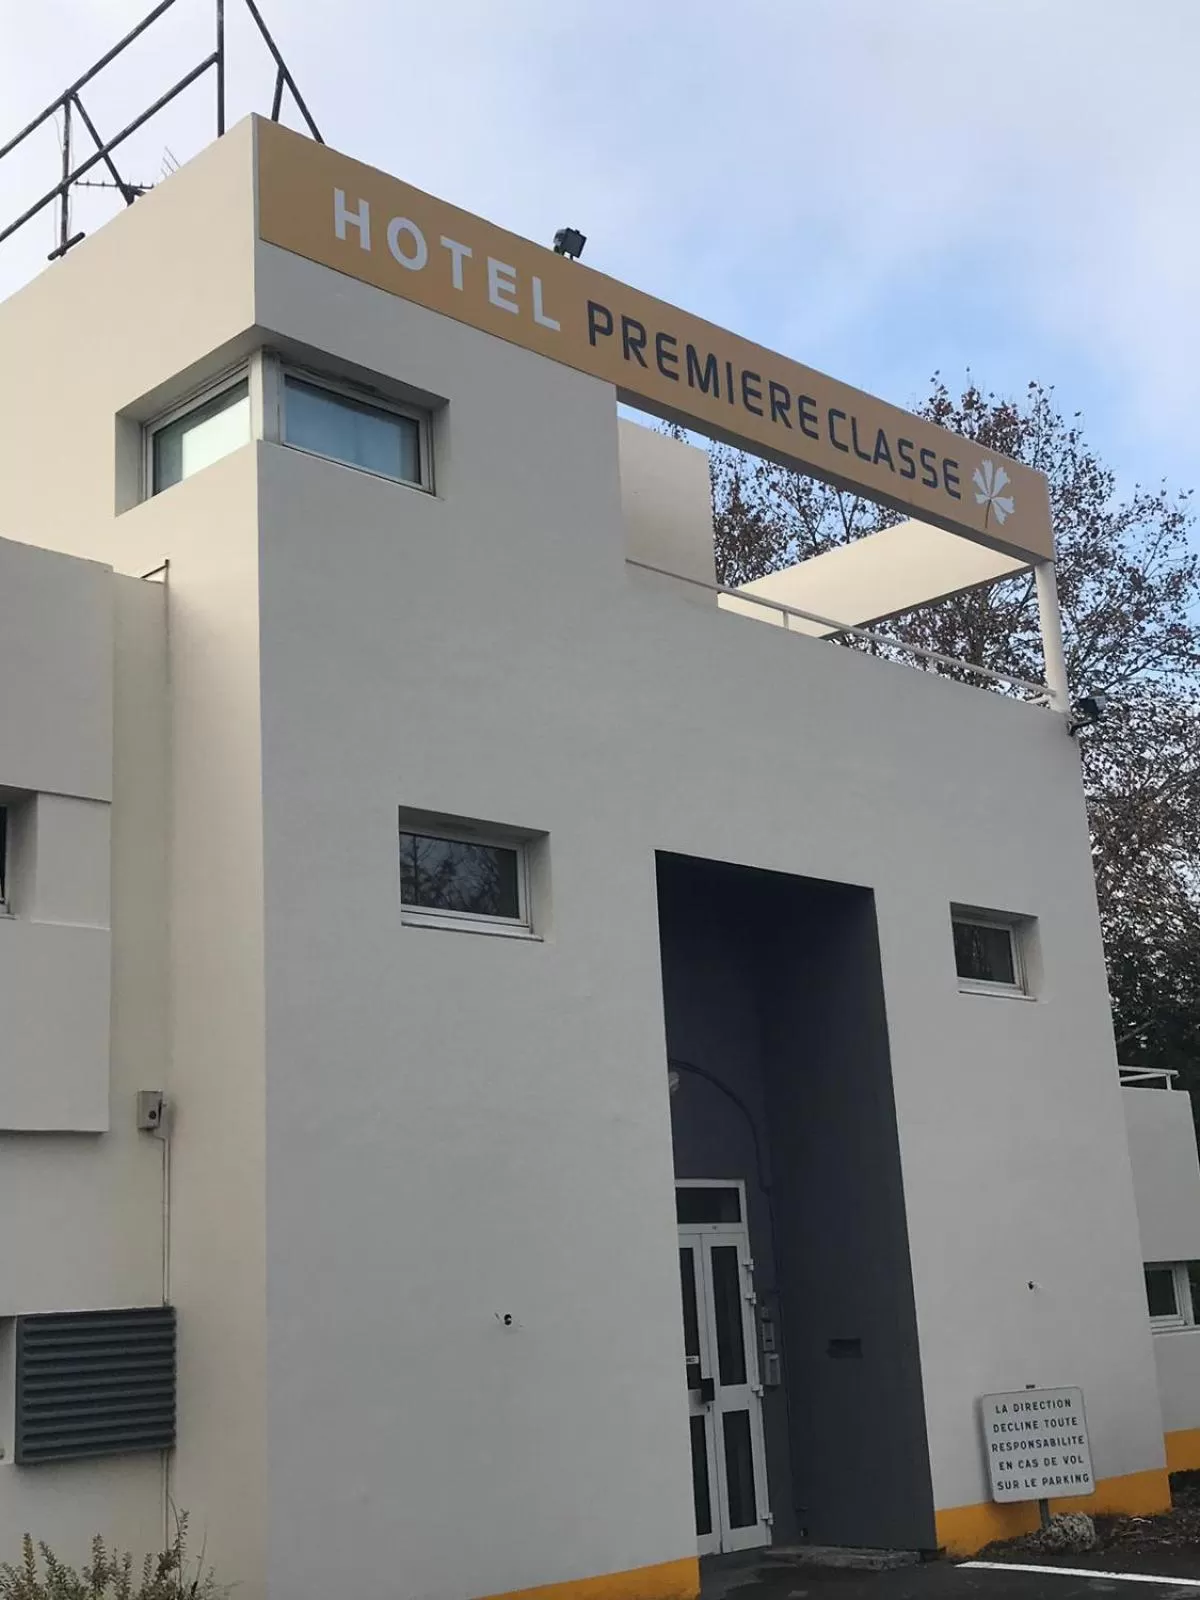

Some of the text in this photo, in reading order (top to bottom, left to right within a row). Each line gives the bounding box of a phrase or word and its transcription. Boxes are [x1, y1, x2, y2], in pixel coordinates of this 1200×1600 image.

[334, 188, 561, 332] HOTEL
[995, 1398, 1072, 1414] LA DIRECTION
[993, 1417, 1078, 1433] DECLINE TOUTE
[991, 1435, 1085, 1452] RESPONSABILITE
[999, 1454, 1084, 1470] EN CAS DE VOL
[997, 1473, 1089, 1490] SUR LE PARKING
